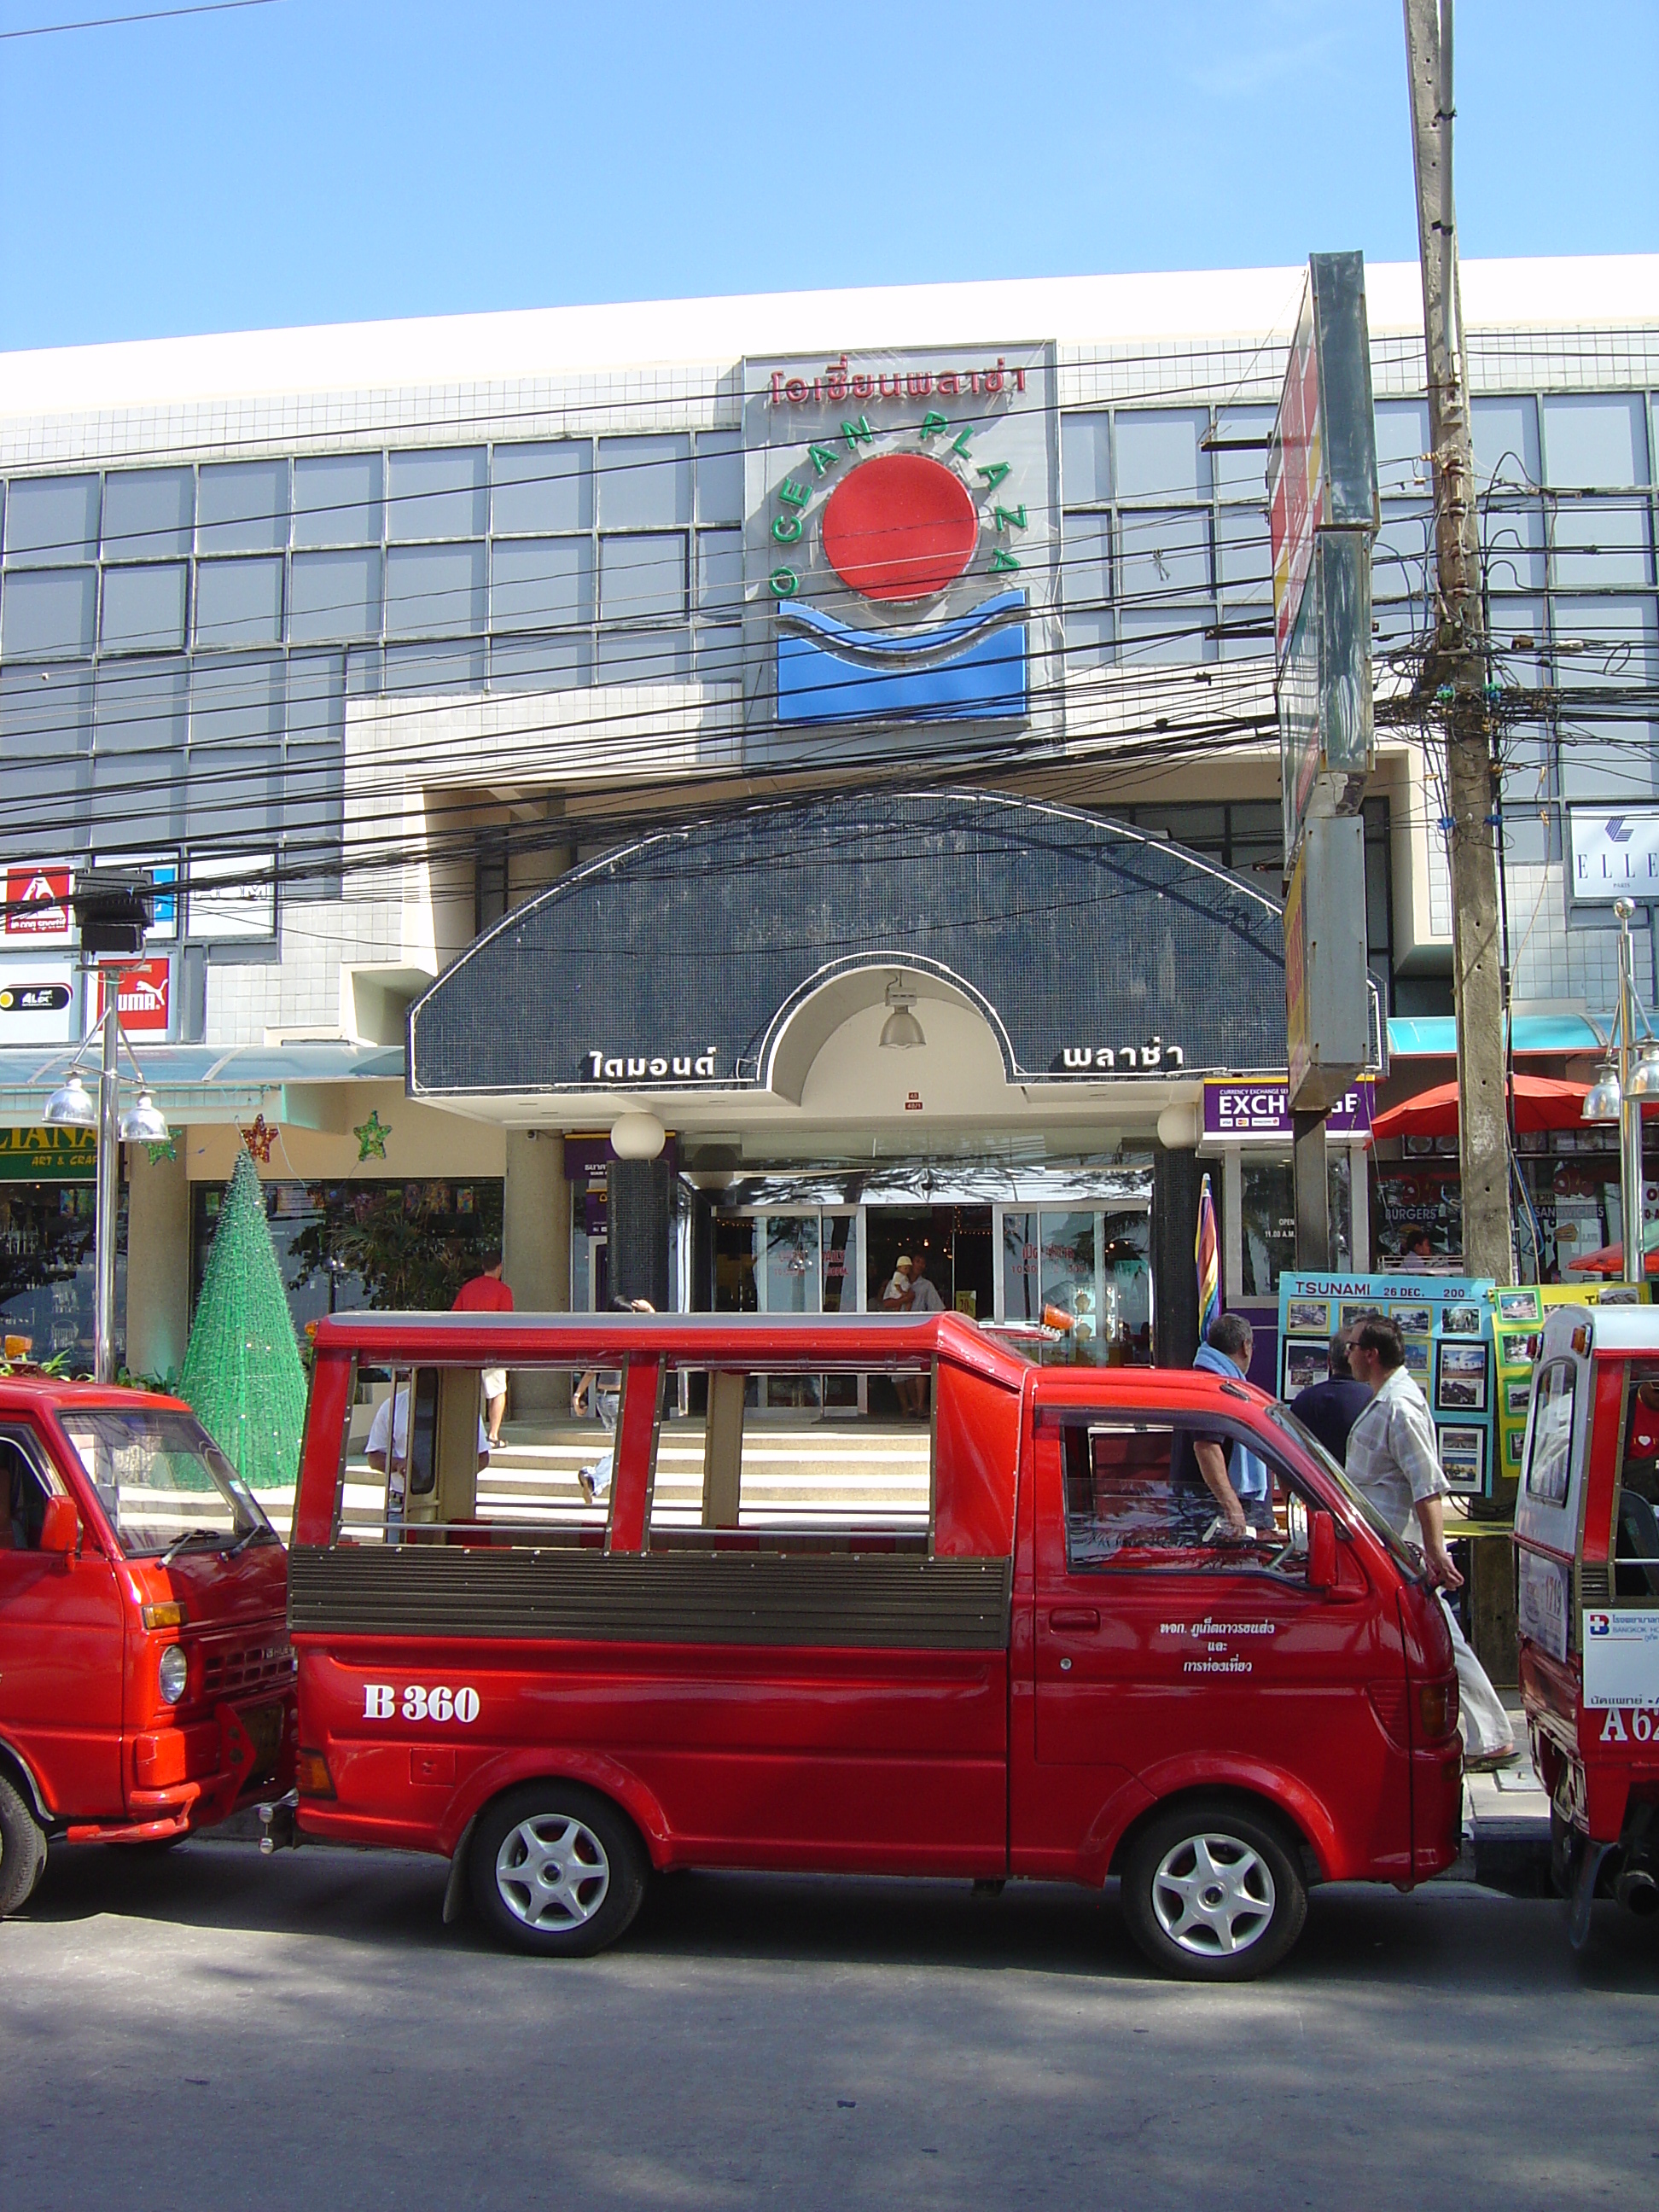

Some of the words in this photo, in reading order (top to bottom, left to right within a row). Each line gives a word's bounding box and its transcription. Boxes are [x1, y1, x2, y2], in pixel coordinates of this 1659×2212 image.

[769, 415, 876, 597] OCEAN
[919, 410, 1029, 573] PLAZA
[1576, 853, 1659, 879] ELLE
[118, 993, 155, 1011] UMA
[1063, 1036, 1185, 1068] พลาซ่า
[589, 1046, 715, 1077] ไดมอนด์
[32, 1155, 52, 1166] ART
[57, 1155, 65, 1166] &
[69, 1155, 97, 1166] CRAF
[1385, 1208, 1437, 1220] BURGERS
[1535, 1206, 1604, 1218] SANDWICHES
[1295, 1281, 1371, 1296] TSUNAMI
[1383, 1287, 1397, 1296] 26
[1400, 1287, 1425, 1297] DEC.
[1443, 1289, 1472, 1298] 200
[1208, 1640, 1228, 1651] และ
[402, 1685, 480, 1723] 360
